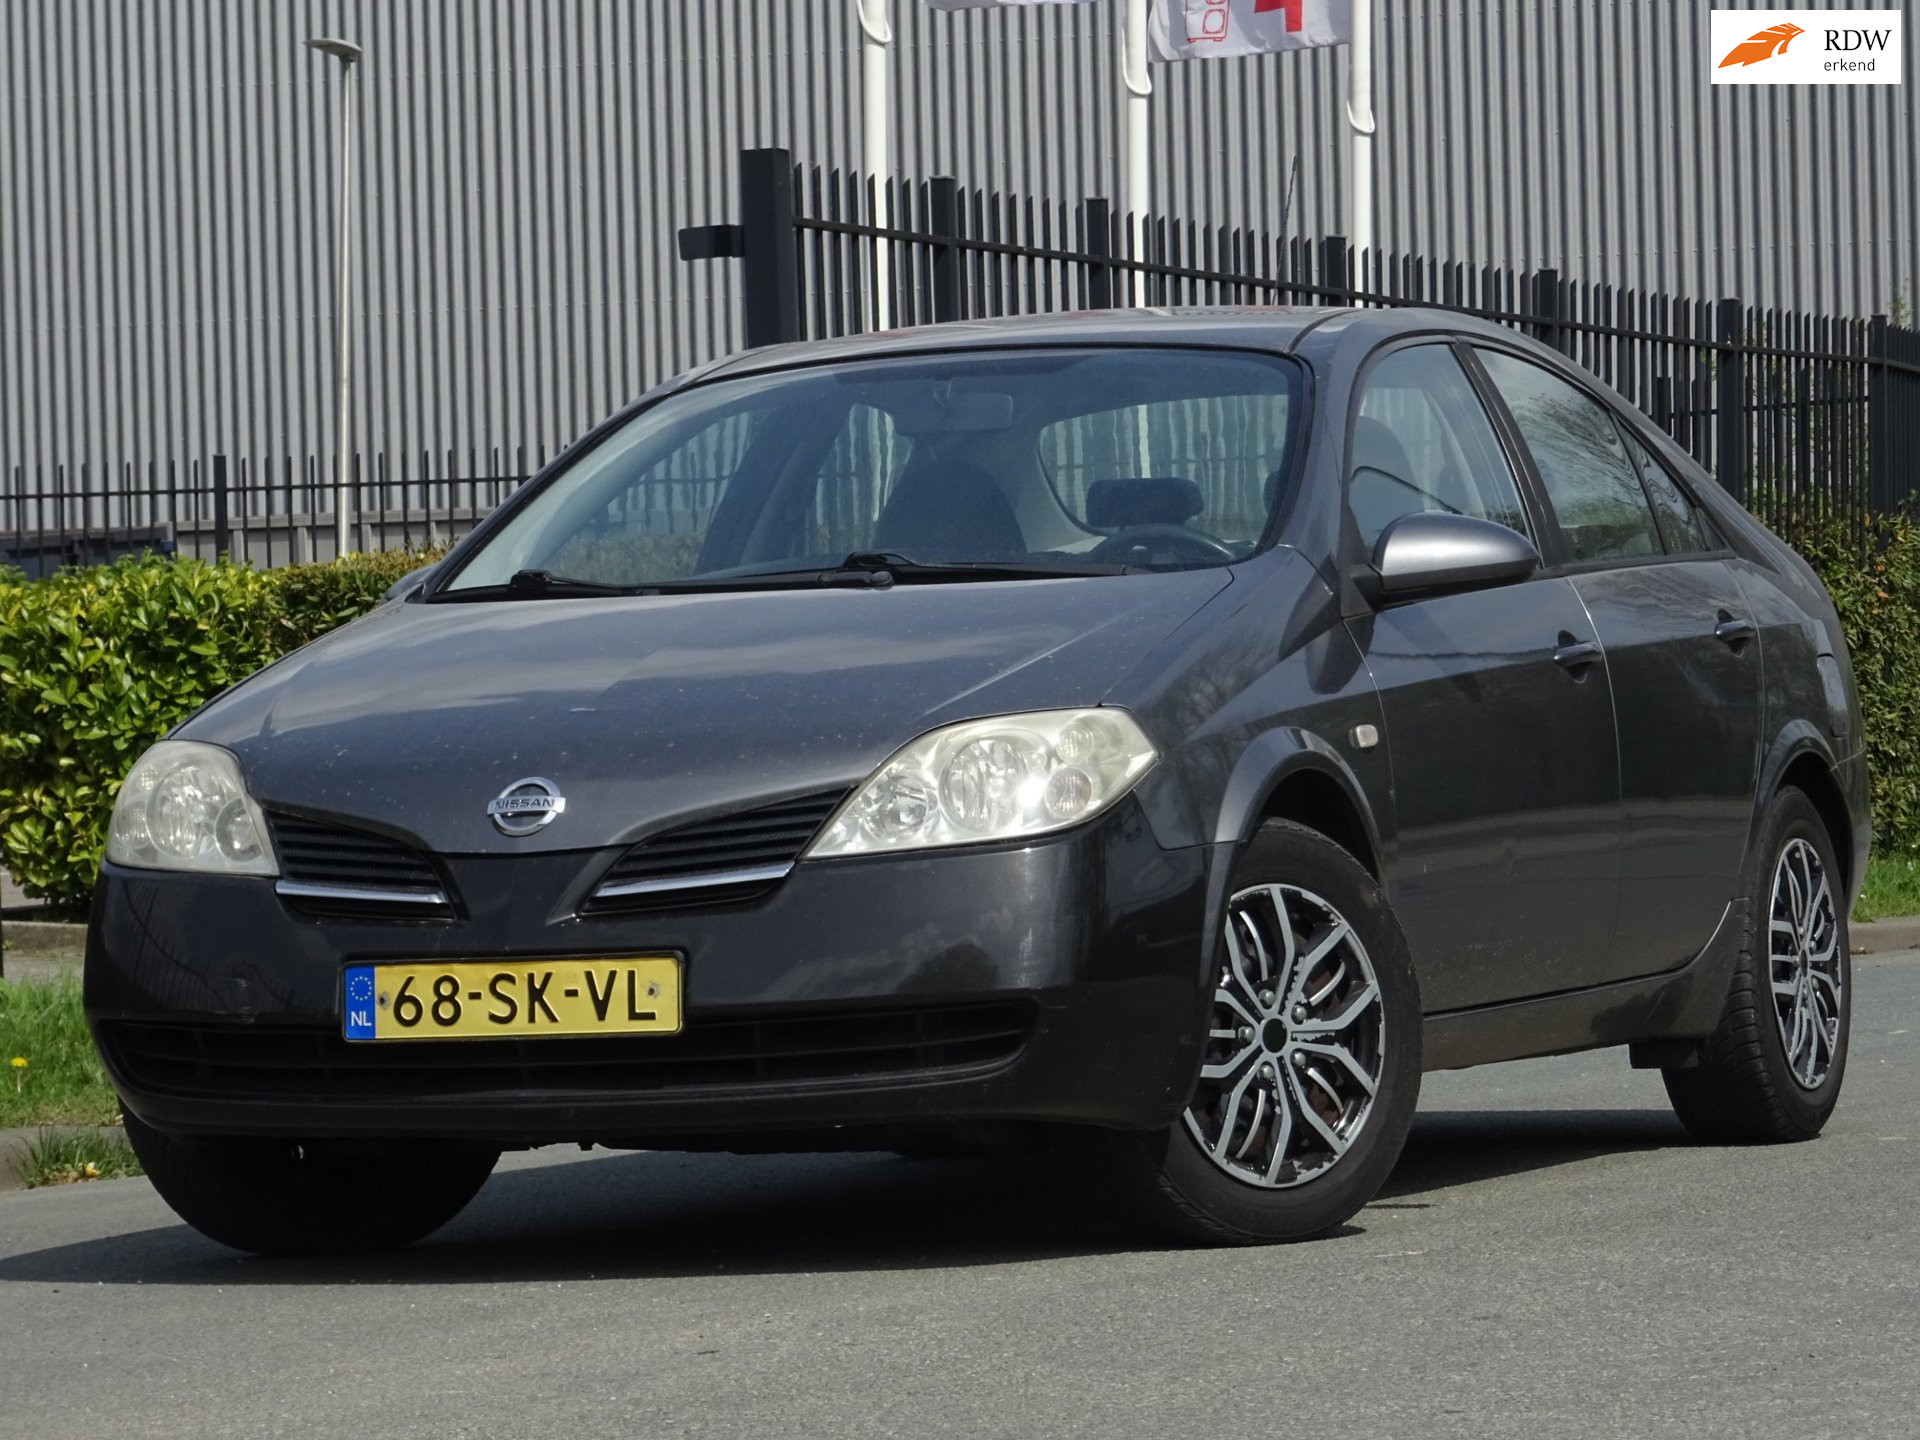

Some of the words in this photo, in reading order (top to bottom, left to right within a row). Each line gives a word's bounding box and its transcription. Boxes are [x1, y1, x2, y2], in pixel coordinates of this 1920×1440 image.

[494, 798, 555, 810] NISSAN
[393, 969, 657, 1028] 68-SK-VL
[350, 1010, 373, 1027] NL
